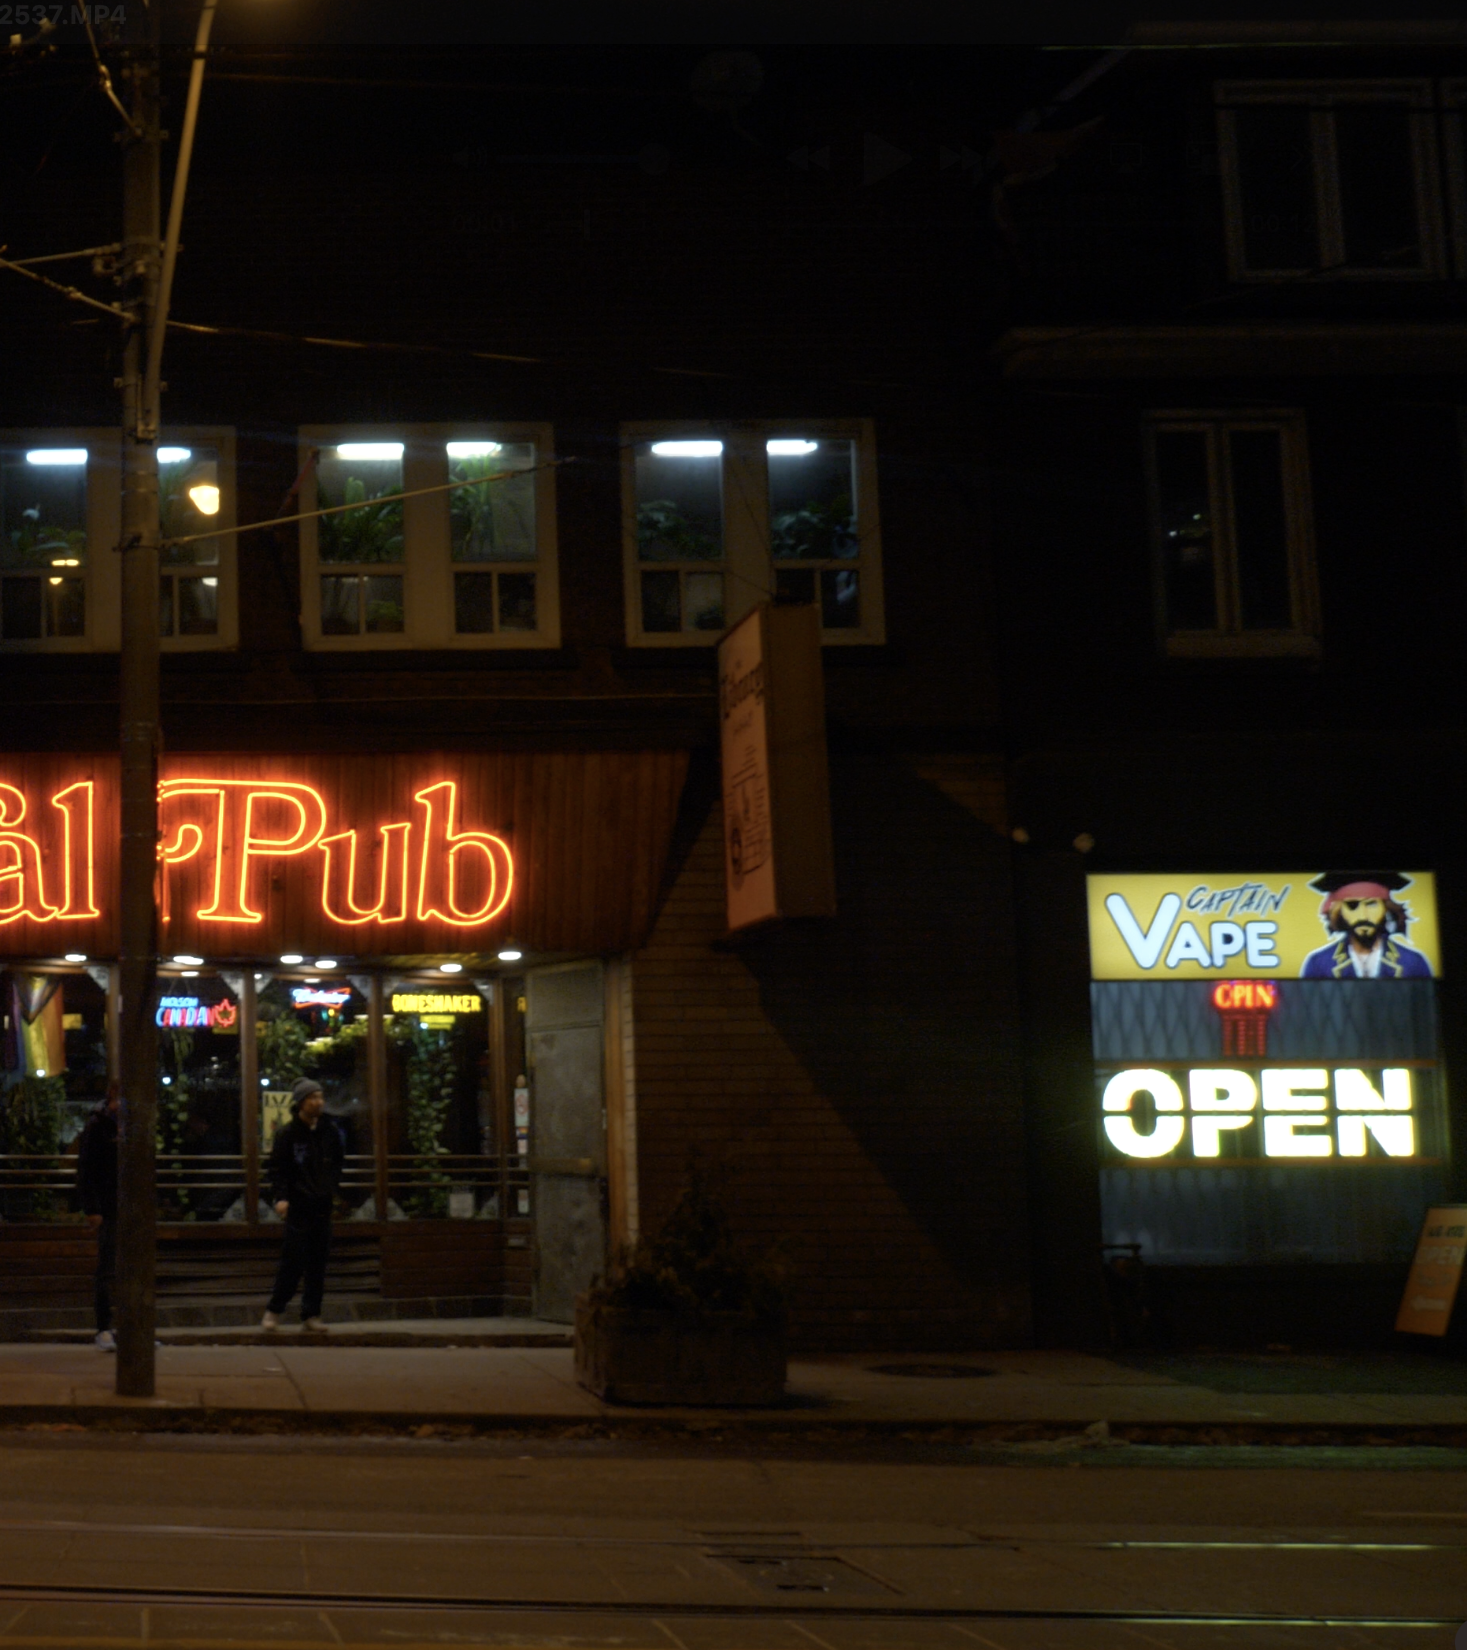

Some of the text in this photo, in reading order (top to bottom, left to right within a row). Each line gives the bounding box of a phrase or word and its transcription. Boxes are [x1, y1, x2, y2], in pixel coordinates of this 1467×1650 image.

[157, 777, 514, 926] Pub
[1104, 892, 1281, 970] VAPE
[1186, 882, 1292, 918] CAPTAIN
[1102, 1068, 1416, 1159] OPEN
